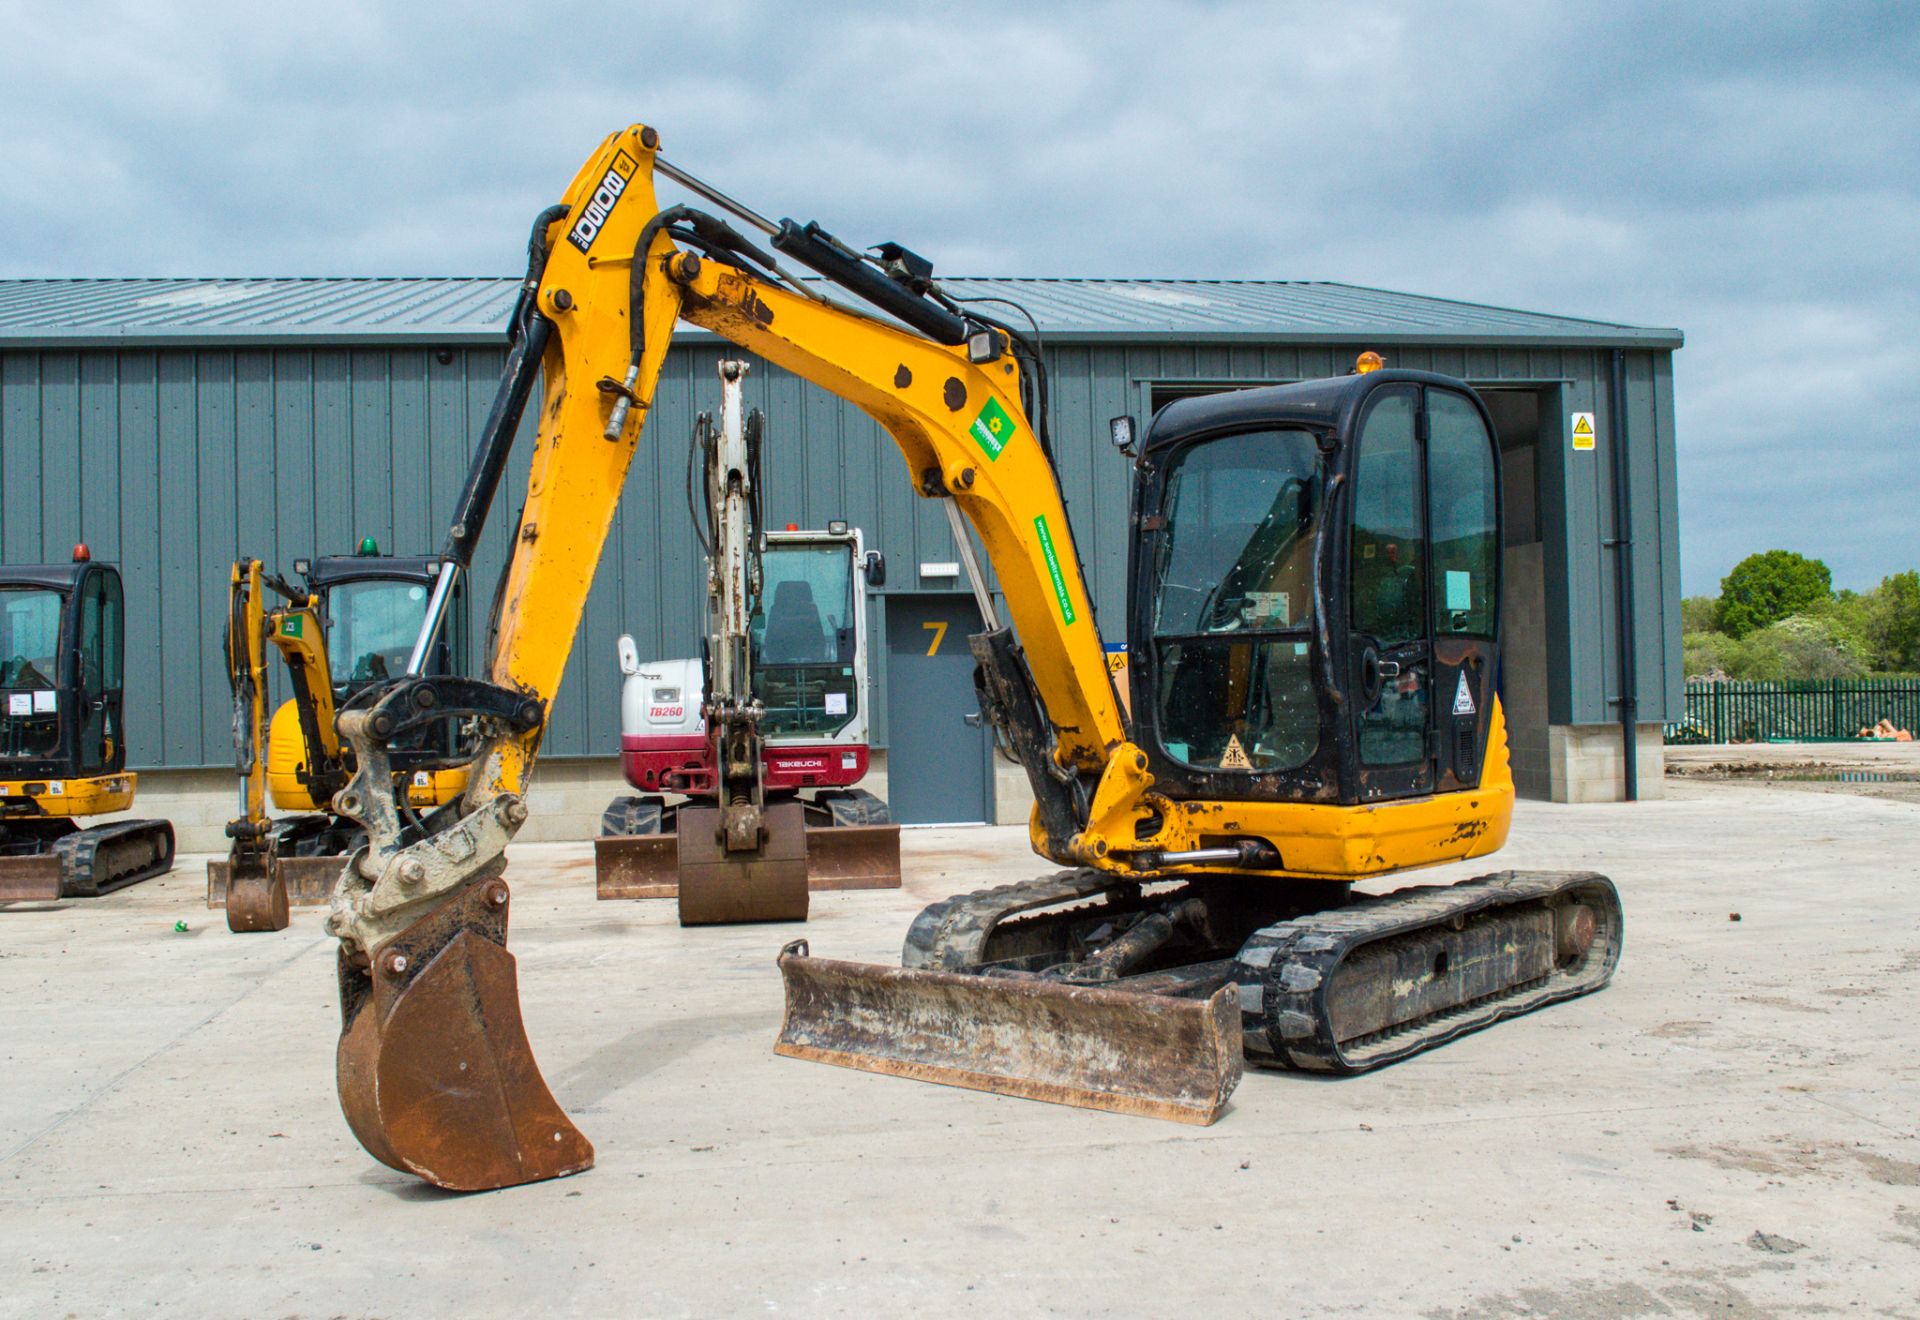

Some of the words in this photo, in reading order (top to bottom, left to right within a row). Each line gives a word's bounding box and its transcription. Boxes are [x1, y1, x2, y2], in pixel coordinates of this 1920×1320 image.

[574, 169, 627, 243] 8050
[922, 621, 949, 656] 7
[649, 706, 683, 717] TB260
[776, 760, 822, 768] TAKEUCHI
